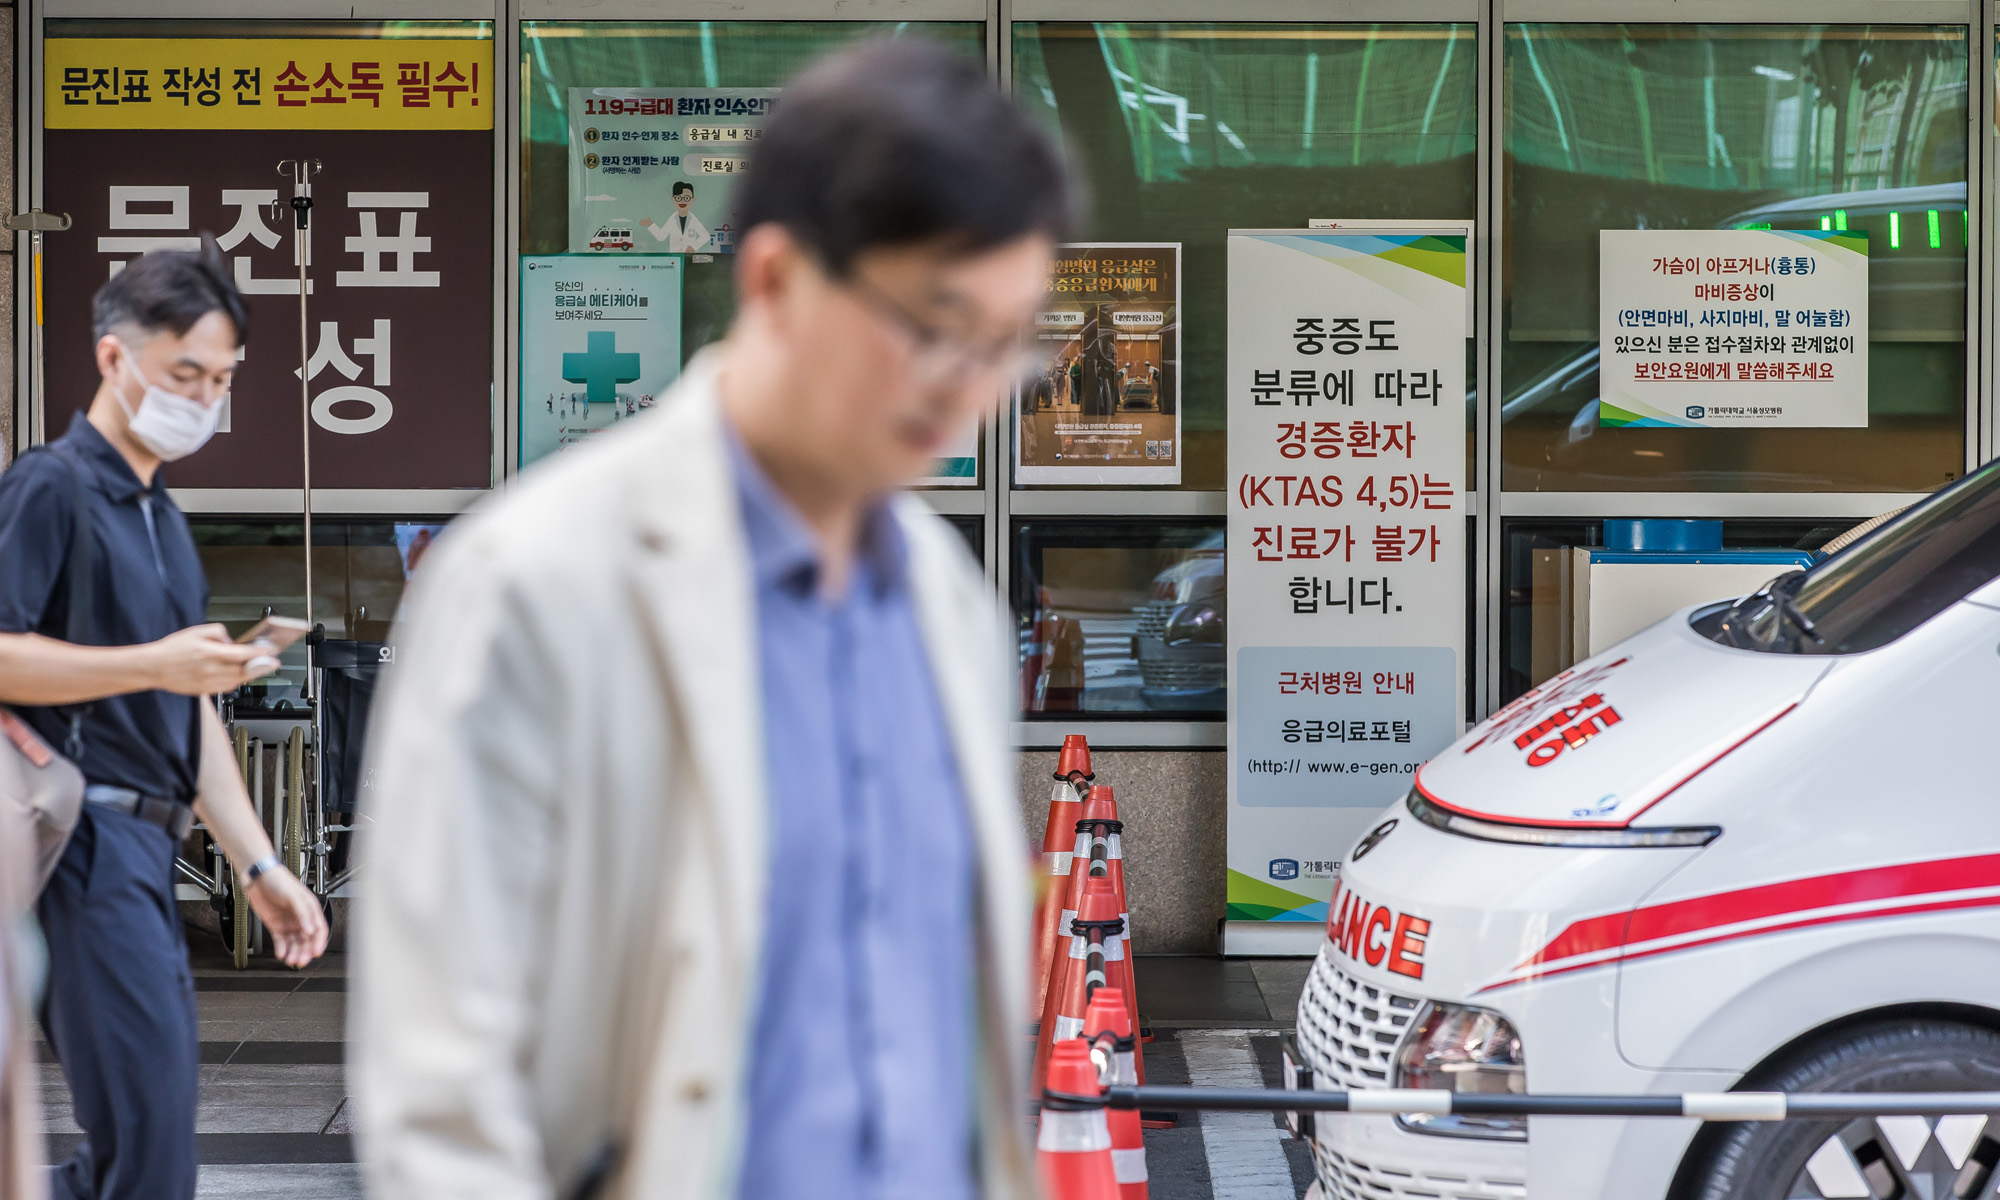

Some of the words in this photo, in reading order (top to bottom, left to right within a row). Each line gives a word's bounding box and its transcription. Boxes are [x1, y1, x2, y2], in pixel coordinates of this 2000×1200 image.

[60, 66, 152, 106] 문진표
[161, 66, 222, 107] 작성
[232, 66, 261, 106] 전
[273, 60, 384, 108] 손소독
[396, 60, 480, 109] 필수!
[585, 98, 674, 116] 119구급대
[677, 97, 711, 116] 환자
[601, 131, 620, 141] 환자
[661, 131, 680, 142] 장소
[689, 128, 721, 141] 응급실
[727, 128, 737, 140] 내
[601, 156, 620, 166] 환자
[622, 156, 659, 166] 인계받는
[661, 156, 680, 166] 사람
[702, 160, 733, 173] 진료실
[97, 183, 441, 296] 문진표
[1100, 259, 1158, 274] 응급실은
[1652, 256, 1701, 276] 가슴이
[1706, 256, 1816, 276] 아프거나(흉통)
[554, 281, 584, 292] 당신의
[1694, 283, 1775, 302] 마비증상이
[554, 295, 587, 307] 응급실
[589, 294, 648, 307] 에티케어를
[554, 309, 604, 320] 보여주세요
[1618, 309, 1694, 329] (안면마비,
[1699, 309, 1769, 329] 사지마비,
[1774, 309, 1791, 328] 말
[1795, 309, 1851, 328] 어눌함)
[1292, 317, 1400, 355] 중증도
[1614, 335, 1662, 354] 있으신
[1667, 335, 1700, 354] 분은
[1704, 335, 1787, 354] 접수절차와
[1791, 335, 1855, 354] 관계없이
[1634, 361, 1731, 381] 보안요원에게
[1736, 361, 1835, 381] 말씀해주세요
[1250, 368, 1355, 407] 분류에
[1374, 368, 1444, 407] 따라
[1275, 420, 1417, 459] 경증환자
[1239, 473, 1343, 509] (KTAS
[1356, 473, 1455, 513] 4,5)는
[1251, 524, 1356, 563] 진료가
[1371, 524, 1441, 563] 불가
[1288, 576, 1404, 615] 합니다.
[378, 646, 396, 665] 외
[1278, 671, 1363, 696] 근처병원
[1372, 671, 1415, 696] 안내
[1281, 719, 1412, 744] 응급의료포털
[1247, 758, 1301, 776] (http://
[1307, 759, 1424, 776] www.e-gen.or
[1327, 876, 1433, 981] LANCE
